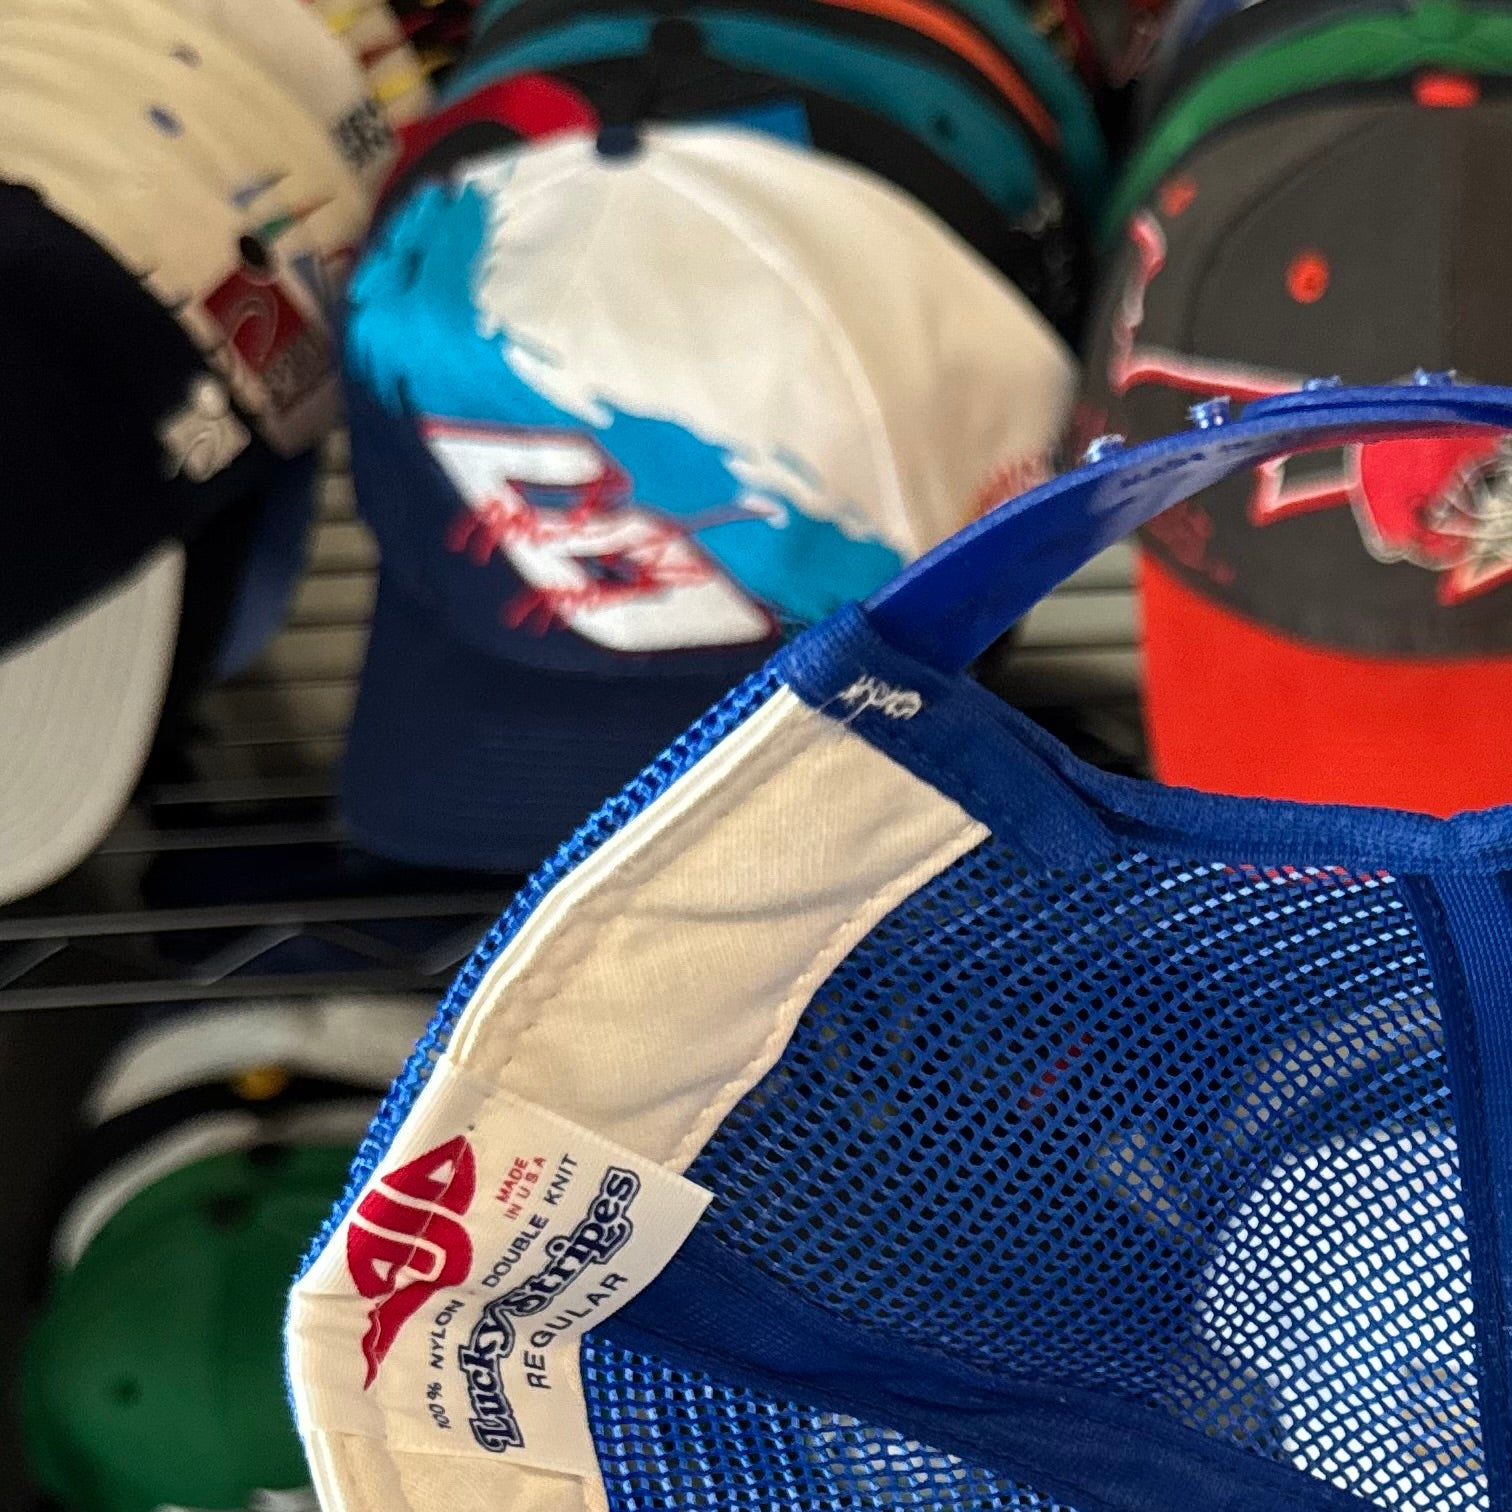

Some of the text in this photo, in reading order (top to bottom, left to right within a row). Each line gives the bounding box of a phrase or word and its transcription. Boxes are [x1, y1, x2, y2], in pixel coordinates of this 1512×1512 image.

[495, 1156, 529, 1203] MADE
[503, 1203, 523, 1221] IN
[430, 1299, 465, 1370] NYLON
[481, 1213, 550, 1288] DOUBLE
[543, 1153, 578, 1206] KNIT
[523, 1272, 629, 1390] REGULAR
